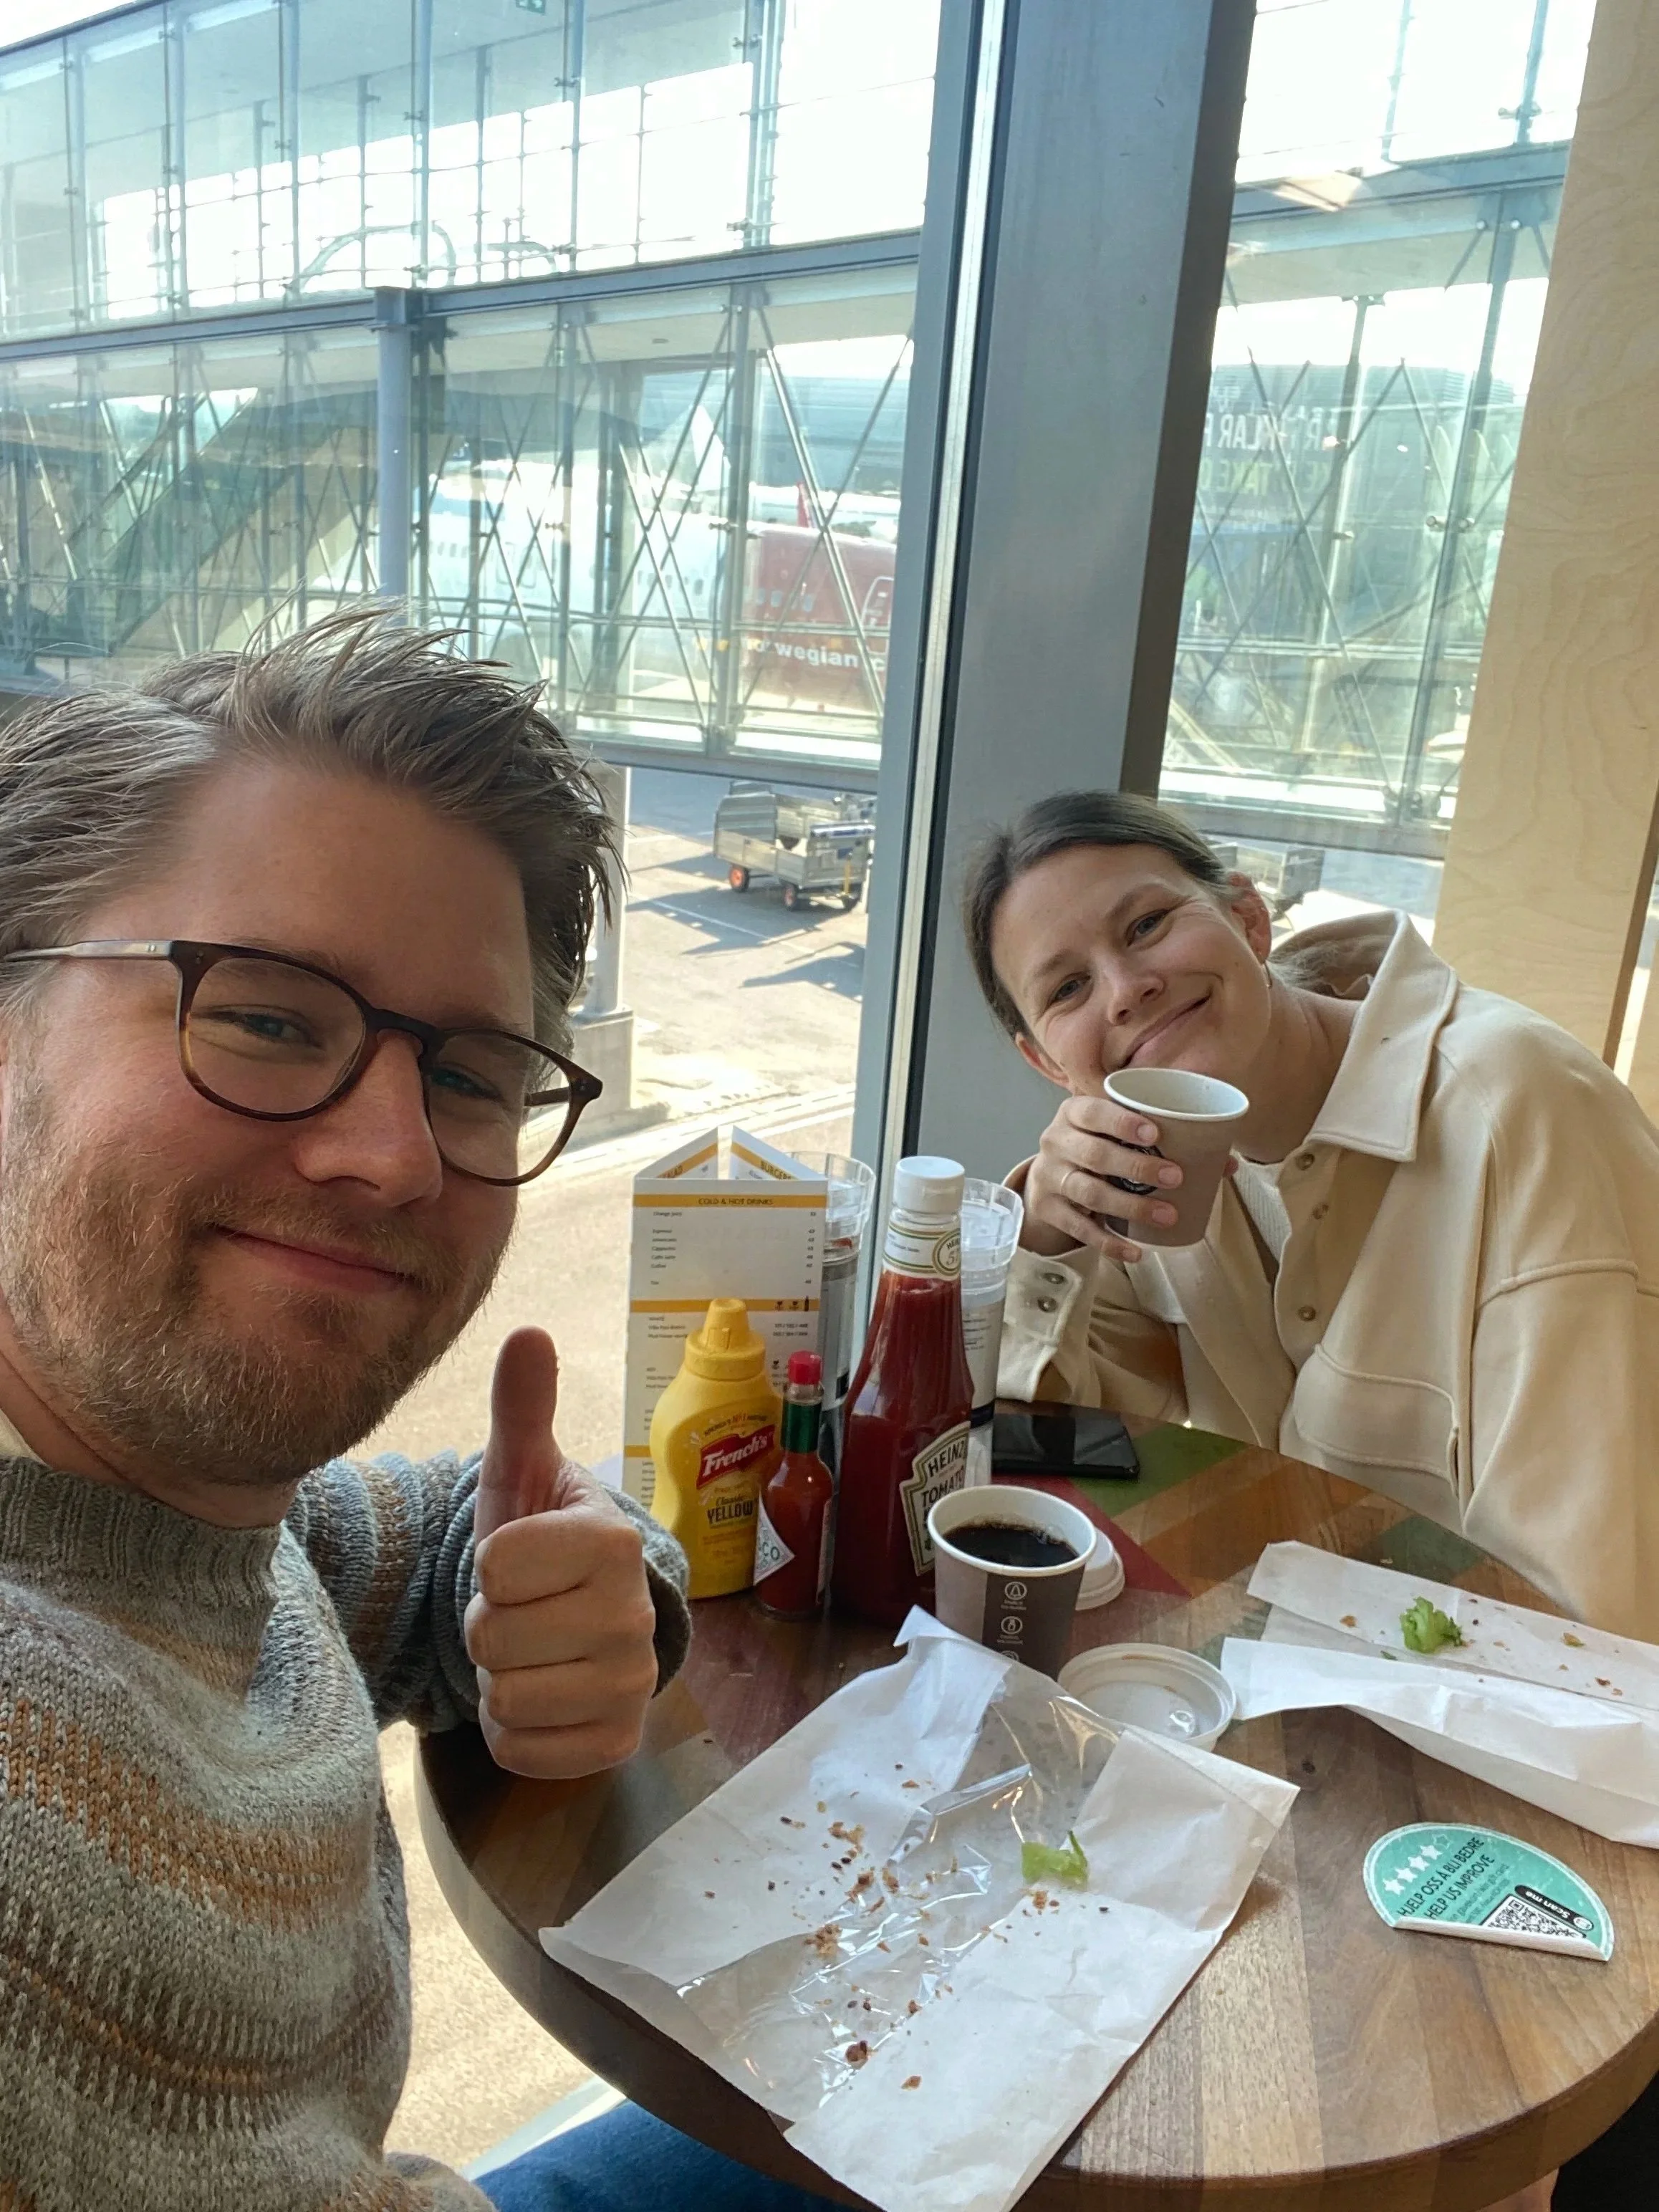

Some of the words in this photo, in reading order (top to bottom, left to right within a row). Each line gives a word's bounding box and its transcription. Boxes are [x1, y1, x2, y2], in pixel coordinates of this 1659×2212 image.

[702, 1435, 768, 1477] French's
[707, 1500, 753, 1524] YELLOW
[1398, 1893, 1425, 1916] HJELP
[1421, 1877, 1444, 1895] OSS
[1443, 1860, 1462, 1874] BLI
[1454, 1837, 1485, 1862] BEDRE
[1424, 1898, 1449, 1919] HELP
[1443, 1886, 1462, 1901] US
[1453, 1854, 1495, 1890] IMPROVE
[1525, 1890, 1544, 1903] me
[1543, 1900, 1571, 1919] Scan
